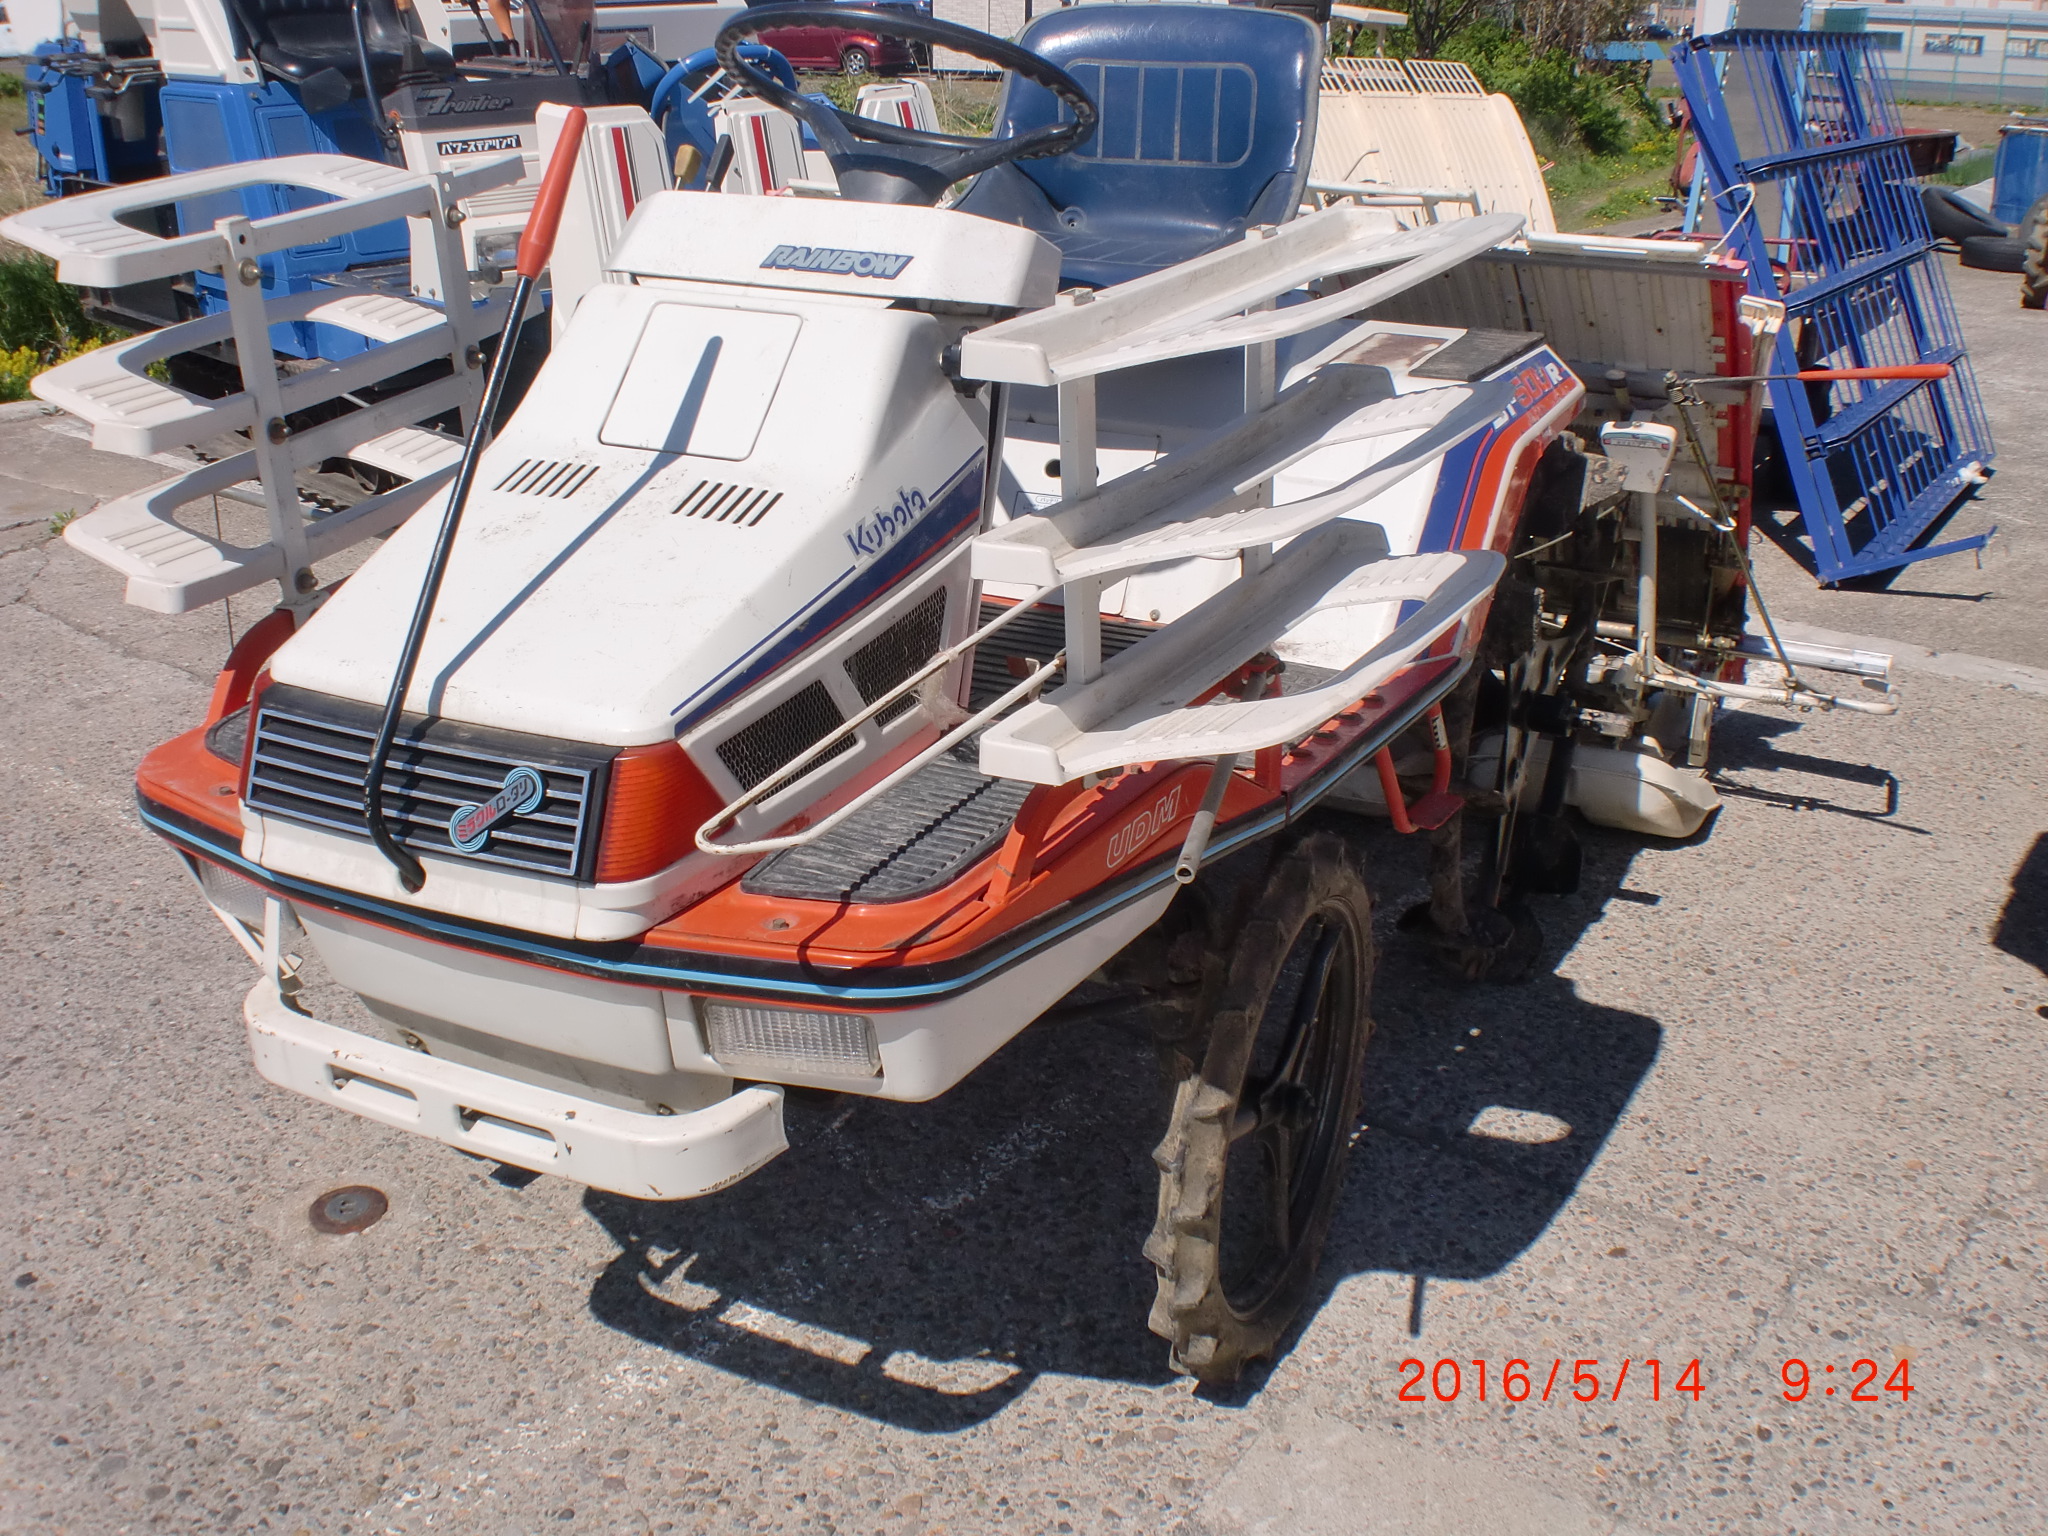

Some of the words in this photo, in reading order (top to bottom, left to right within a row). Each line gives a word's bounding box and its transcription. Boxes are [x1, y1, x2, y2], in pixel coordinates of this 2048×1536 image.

[441, 135, 518, 155] パワーステアリング
[760, 244, 914, 280] RAINBOW
[844, 488, 927, 557] Kubota
[457, 777, 528, 839] ミラクルロータリ
[1106, 784, 1182, 868] UDM
